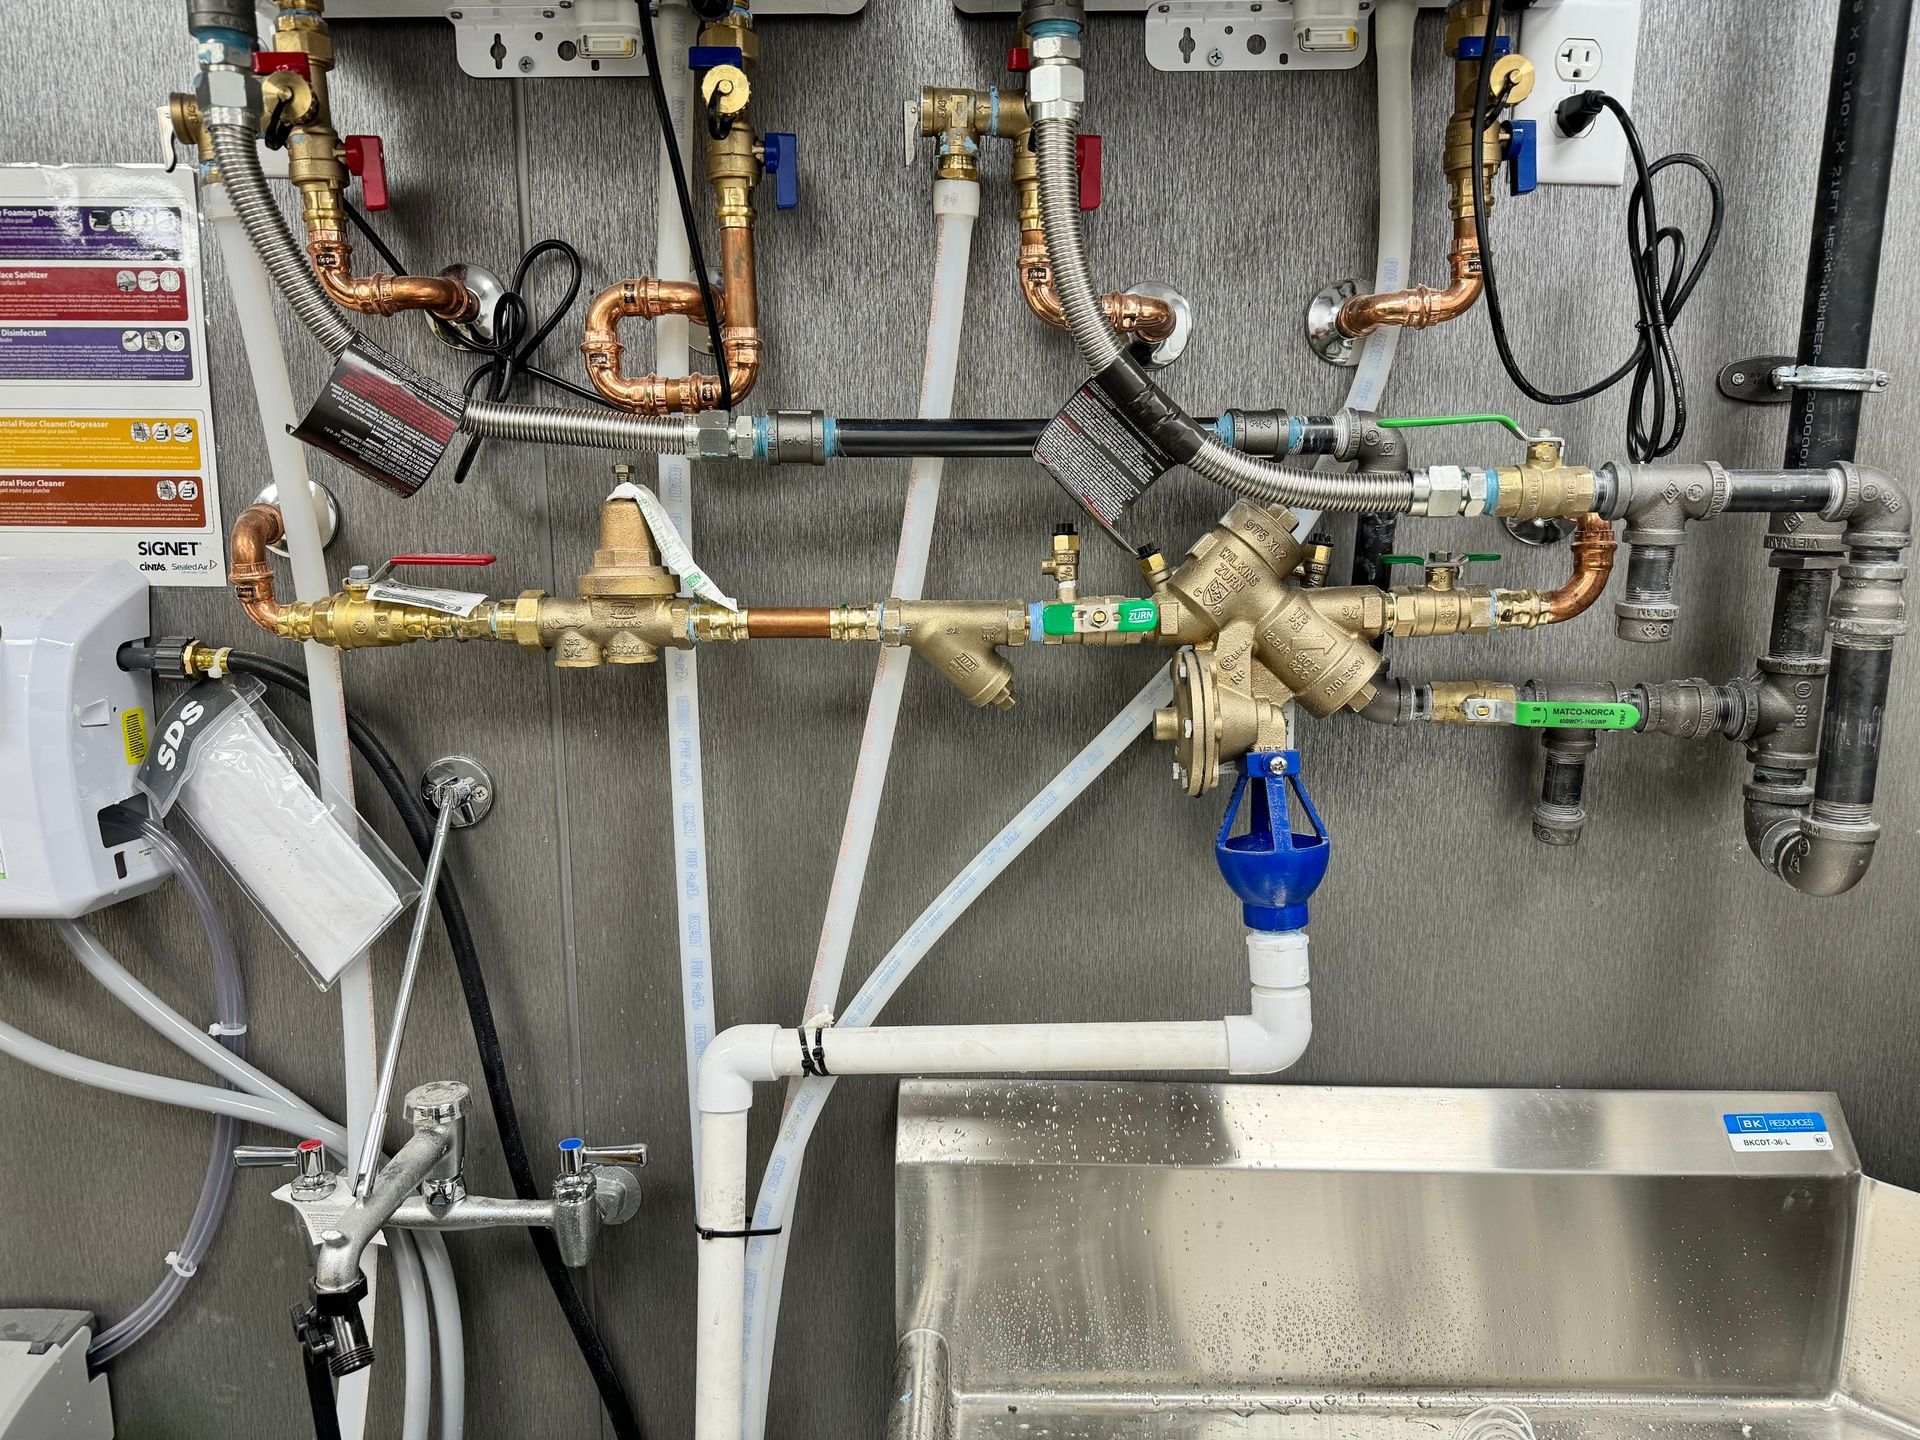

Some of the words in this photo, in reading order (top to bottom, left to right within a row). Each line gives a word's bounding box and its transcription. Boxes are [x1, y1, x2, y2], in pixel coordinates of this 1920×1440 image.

[3, 208, 37, 218] Foaming
[15, 271, 48, 279] Sanitizer
[1, 329, 47, 337] Disinfectant
[19, 420, 38, 428] Floor
[39, 420, 109, 430] Cleaner/Degreaser
[1243, 519, 1268, 541] 975
[1265, 539, 1287, 562] XL2
[138, 541, 200, 556] SIGNET
[1218, 546, 1260, 587] WILKINS
[1214, 563, 1246, 593] ZURN
[1128, 609, 1154, 621] ZURN
[1552, 708, 1615, 716] MATCO-NORCA
[157, 701, 205, 772] SDS
[1743, 1120, 1763, 1128] BK
[1769, 1118, 1814, 1127] RESOURCES
[1743, 1138, 1791, 1147] BKCDT-36-L
